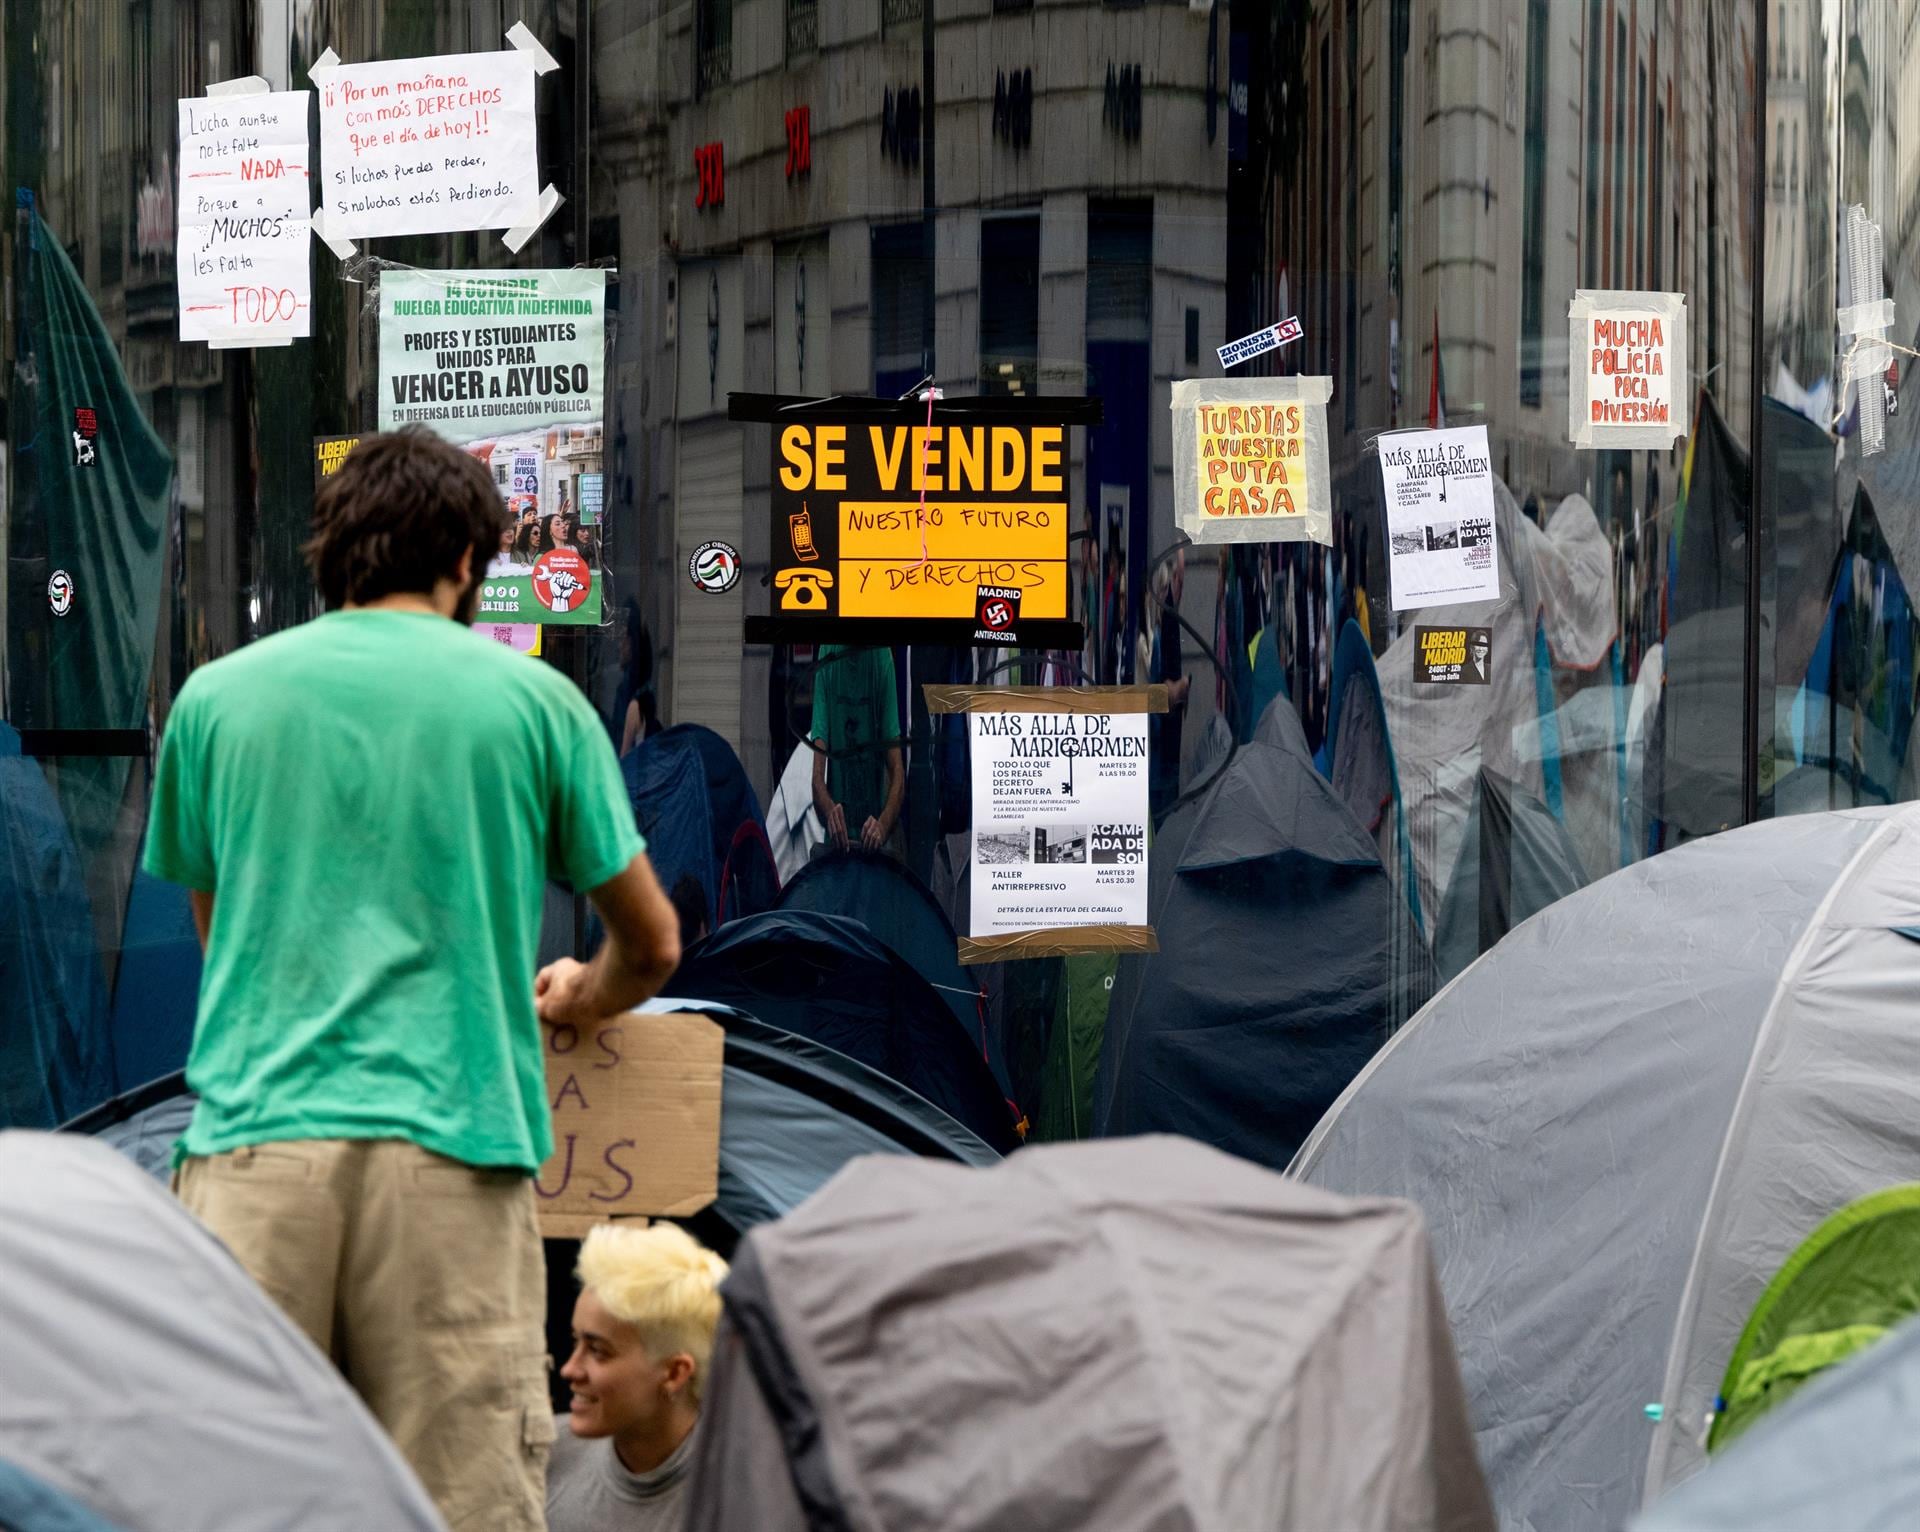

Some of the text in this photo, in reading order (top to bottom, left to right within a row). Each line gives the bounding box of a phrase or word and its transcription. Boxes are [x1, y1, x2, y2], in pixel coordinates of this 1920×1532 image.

[372, 85, 389, 97] un
[397, 74, 468, 95] mañana
[377, 99, 411, 122] más
[416, 88, 502, 117] DERECHOS
[190, 107, 279, 135] Lucha aunque
[350, 109, 489, 156] que el día de hoy!!
[200, 137, 259, 159] no te falte
[351, 166, 388, 184] luchas
[257, 198, 263, 207] a
[409, 188, 440, 205] estás
[193, 252, 253, 276] les falta
[446, 279, 540, 298] 14 OCTUBRE
[224, 286, 296, 324] TODO
[394, 298, 593, 316] HUELGA EDUCATIVA INDEFINIDA
[404, 323, 577, 351] PROFES Y ESTUDIANTES
[1219, 329, 1274, 357] ZIONISTS
[1593, 318, 1664, 347] MUCHA
[436, 346, 536, 370] UNIDOS PARA
[1222, 337, 1277, 365] NOT WELCOME
[392, 363, 589, 405] VENCER A AYUSO
[1614, 375, 1649, 399] POCA
[392, 399, 592, 422] EN DEFENSA DE LA EDUCACIÓN PÚBLICA
[1199, 405, 1300, 436] TURISTAS
[779, 425, 1063, 492] SE VENDE
[1203, 437, 1300, 458] A VUESTRA
[1385, 443, 1466, 467] MÁS ALLÁ DE
[1208, 459, 1288, 485] PUTA
[1396, 480, 1428, 488] CAMPAÑAS
[1204, 486, 1296, 516] CASA
[848, 508, 1050, 531] NUESTRO FUTURO
[1460, 517, 1491, 527] ACAMP
[1460, 527, 1491, 537] ADA DE
[859, 562, 1045, 592] Y DERECHOS
[978, 586, 1021, 599] MADRID
[974, 630, 1017, 642] ANTIFASCISTA
[1421, 631, 1466, 649] LIBERAR
[1424, 647, 1466, 665] MADRID
[979, 709, 1111, 736] MÁS ALLÁ DE
[1033, 761, 1051, 769] QUE
[993, 788, 1023, 796] DEJAN
[1092, 824, 1143, 836] ACAMP
[1092, 838, 1143, 850] ADA DE
[1117, 852, 1143, 864] SOL
[992, 883, 1067, 891] ANTIRREPRESIVO
[997, 905, 1024, 913] DETRÁS
[552, 1073, 590, 1110] A
